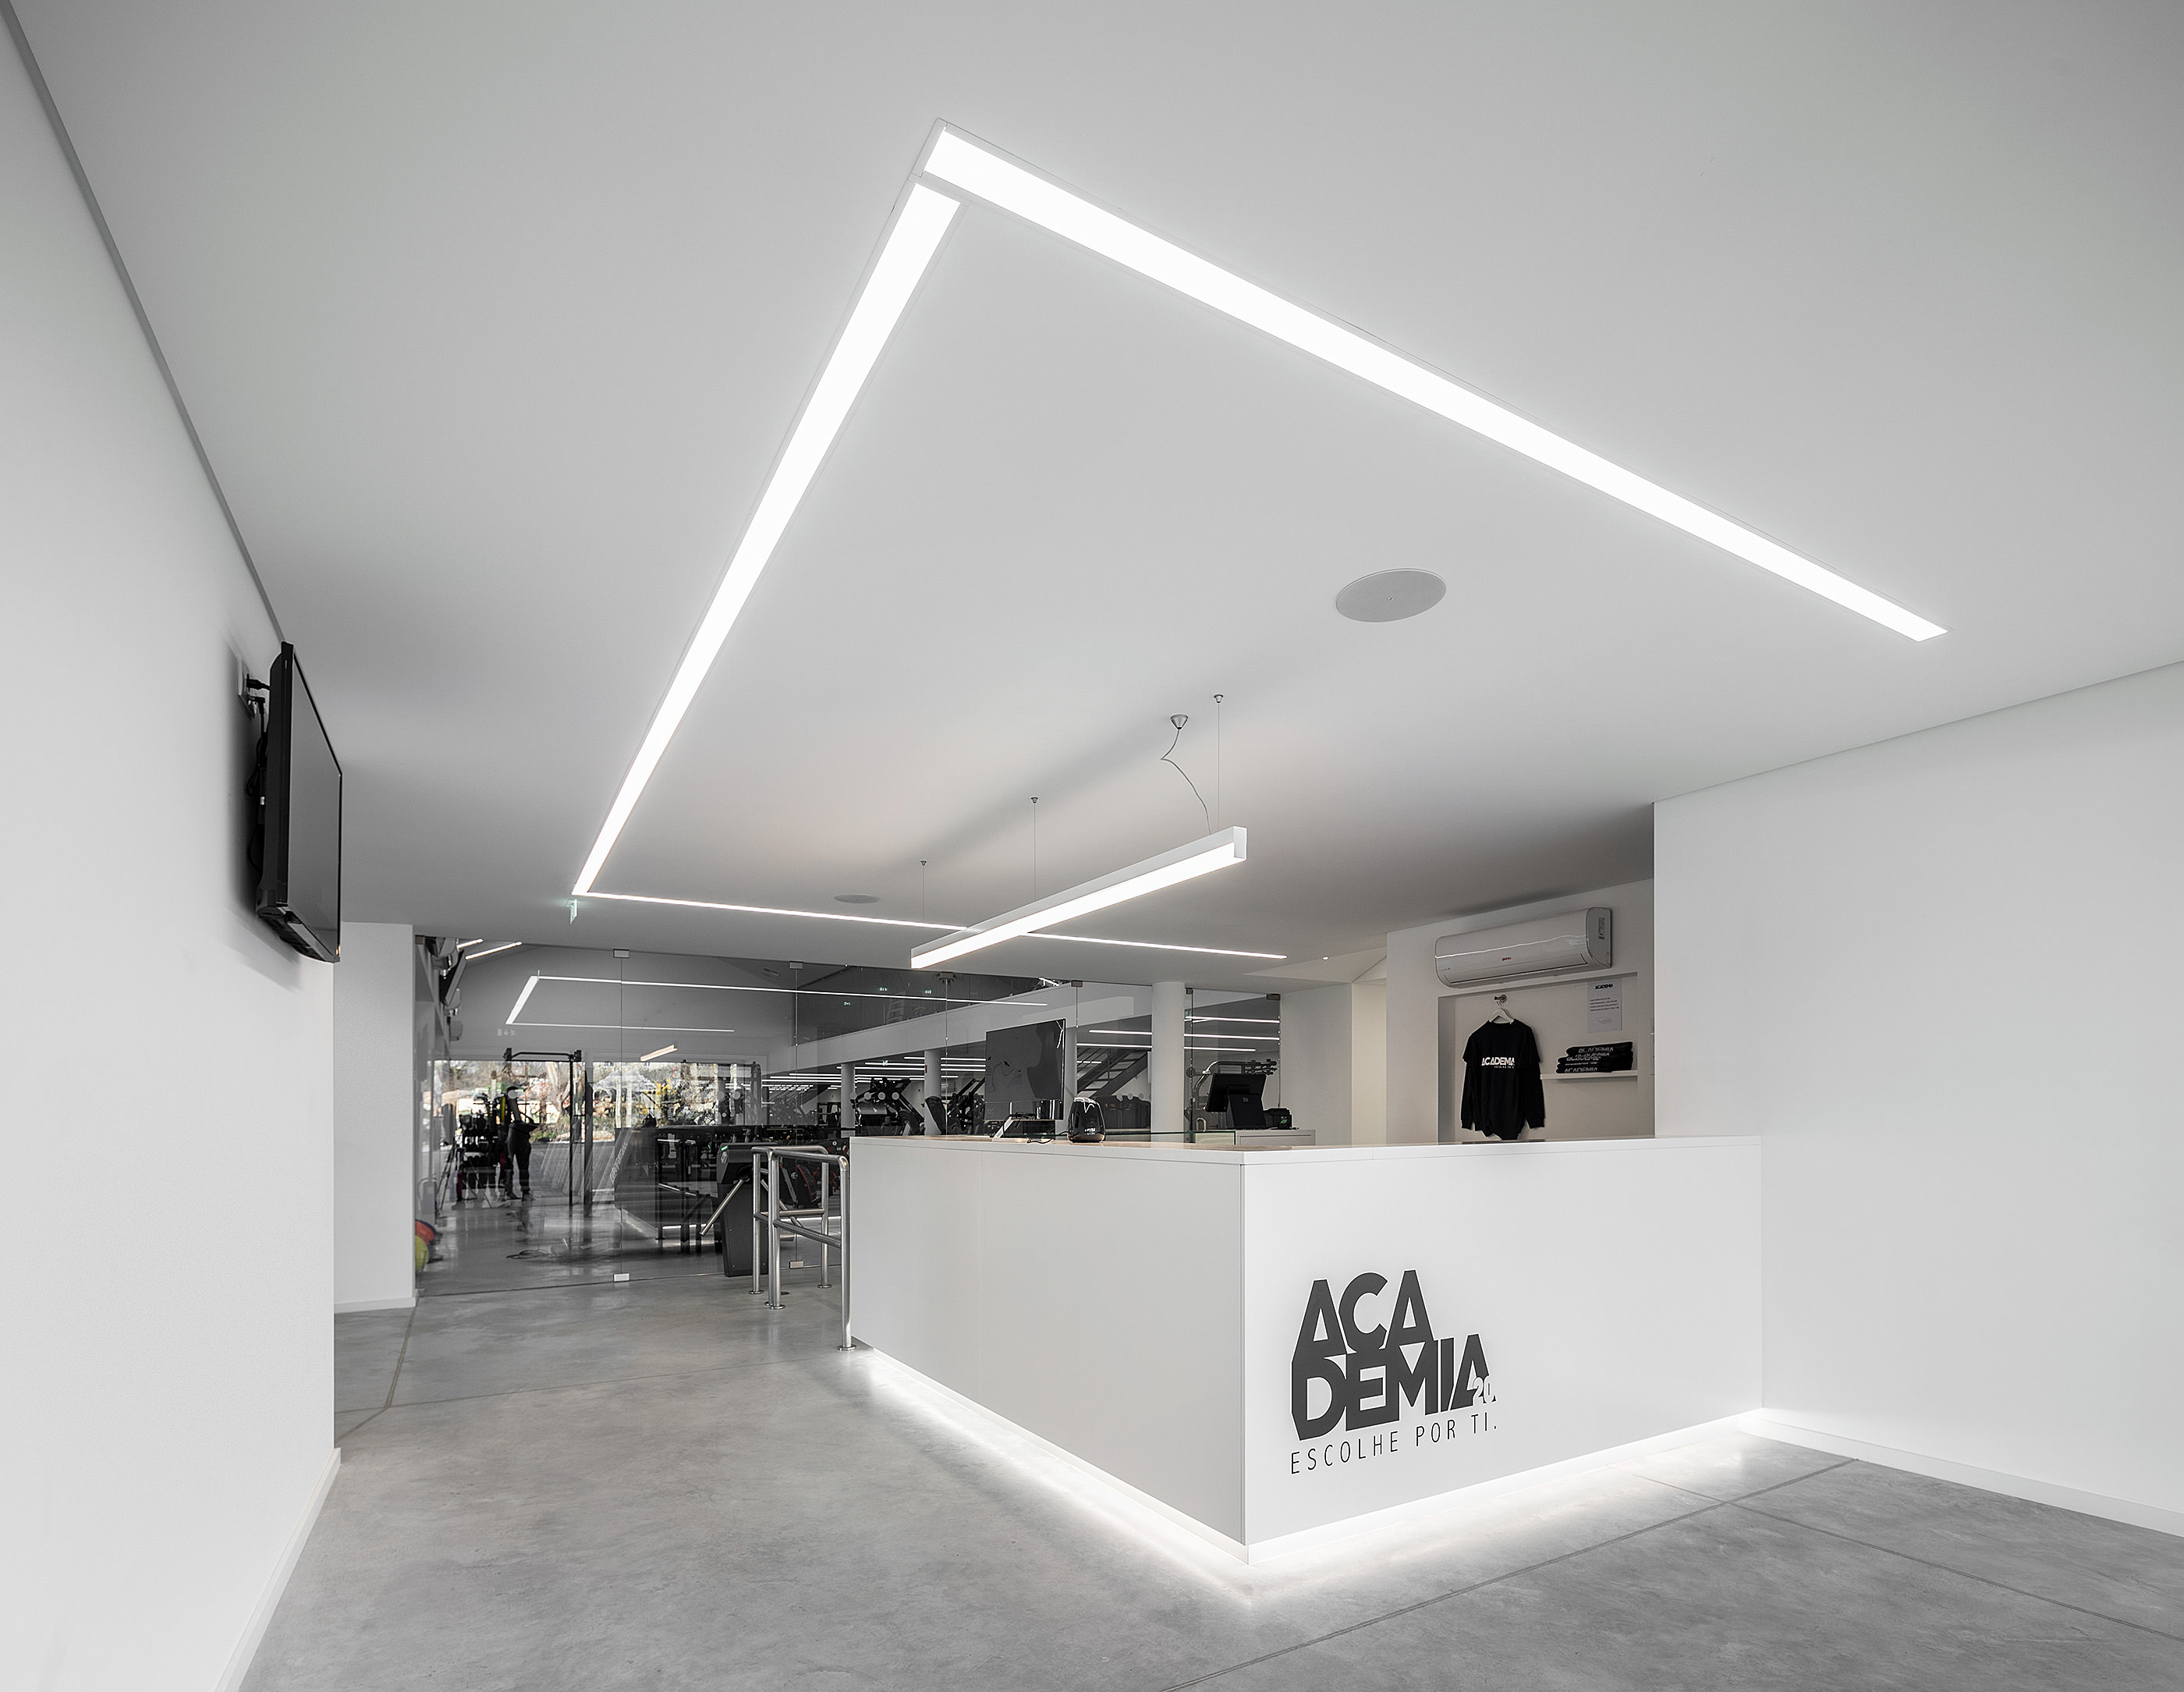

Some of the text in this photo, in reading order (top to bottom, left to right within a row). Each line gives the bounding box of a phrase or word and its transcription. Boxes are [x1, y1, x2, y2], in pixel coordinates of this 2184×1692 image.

[1292, 1269, 1434, 1361] ACA
[1291, 1333, 1496, 1441] DEMIA
[1291, 1412, 1497, 1474] ESCOLHE POR TI.
